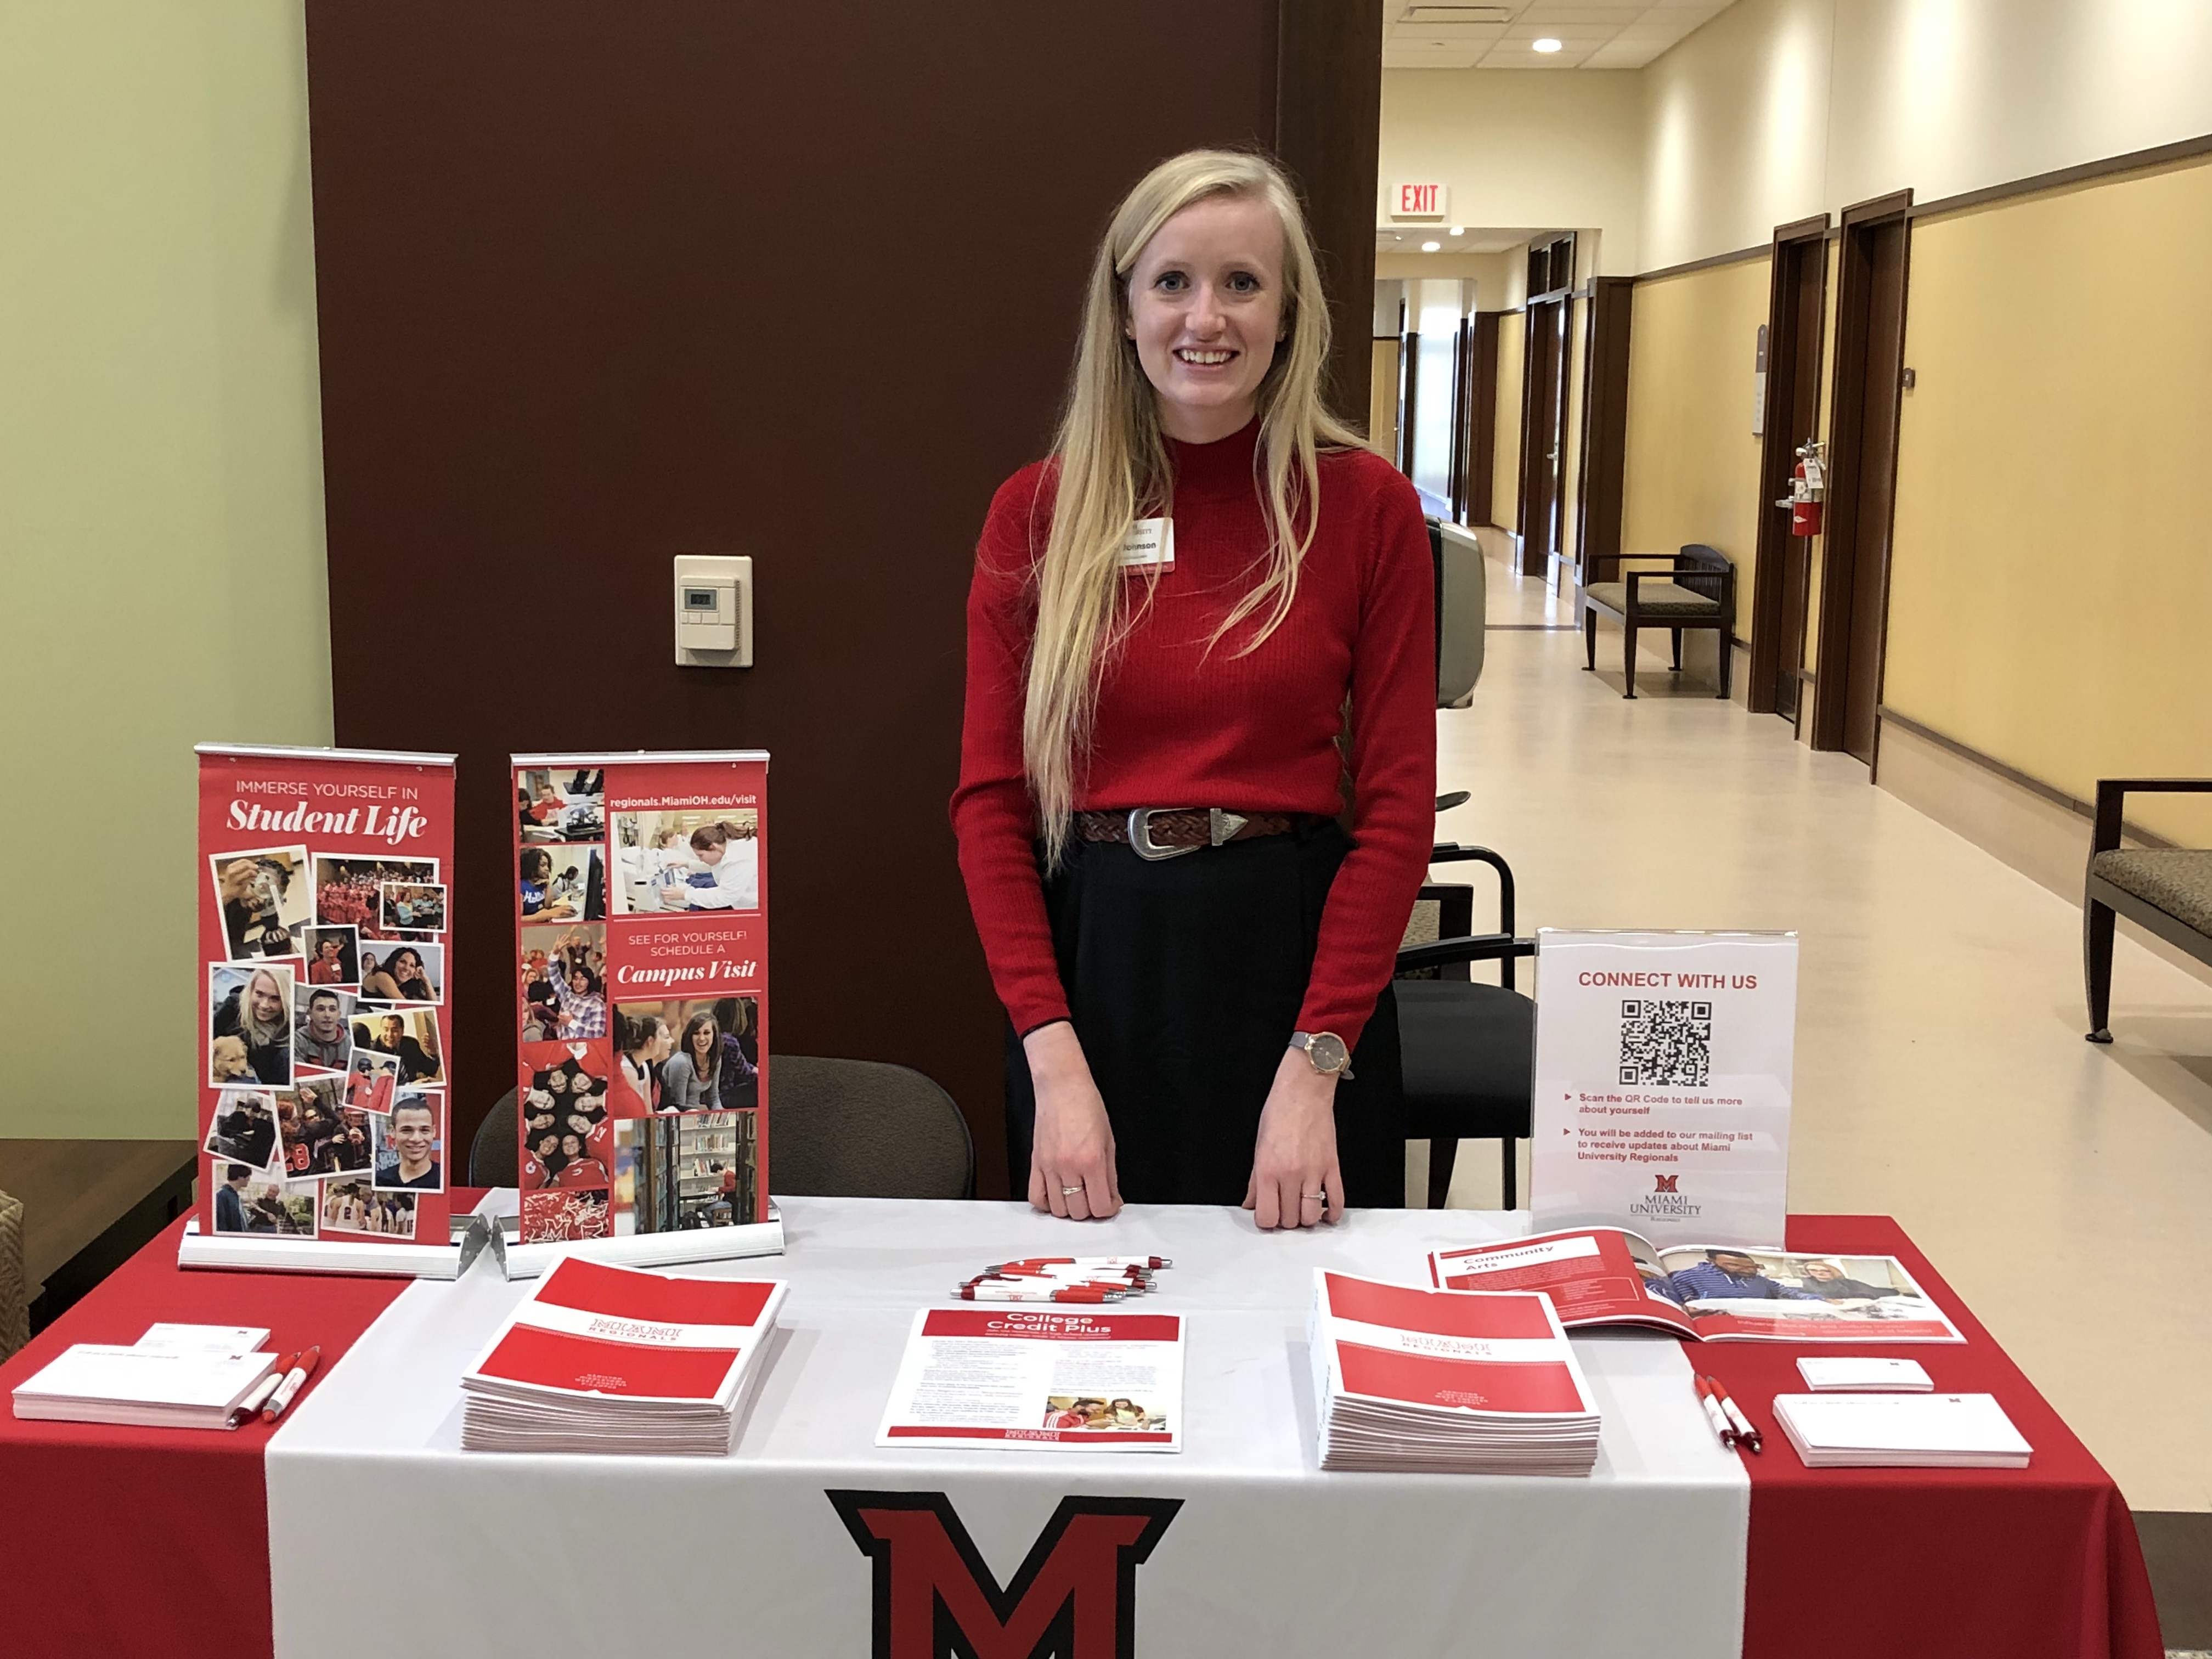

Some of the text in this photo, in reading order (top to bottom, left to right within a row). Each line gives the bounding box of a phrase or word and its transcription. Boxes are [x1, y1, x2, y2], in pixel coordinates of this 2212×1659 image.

[1402, 185, 1438, 212] EXIT
[236, 781, 417, 800] IMMERSE YOURSELF IN
[610, 794, 757, 809] regionals.MiamiOH.edu/visit
[227, 799, 427, 845] Student Life
[629, 931, 747, 945] SEE FOR YOURSELF!
[651, 944, 725, 956] SCHEDULE A
[618, 960, 758, 986] Campus Visit
[1578, 972, 1757, 989] CONNECT WITH US
[1579, 1094, 1604, 1103] Scan
[1606, 1094, 1622, 1103] the
[1625, 1094, 1640, 1104] QR
[1644, 1096, 1668, 1104] Code
[1684, 1096, 1700, 1104] tell
[1579, 1106, 1650, 1115] about yourself
[1578, 1128, 1597, 1137] You
[1599, 1129, 1616, 1137] will
[1619, 1130, 1631, 1138] be
[1634, 1130, 1664, 1138] added
[1699, 1132, 1735, 1142] mailing
[1737, 1132, 1753, 1141] list
[1629, 1142, 1667, 1151] updates
[1671, 1142, 1699, 1151] about
[1701, 1143, 1730, 1152] Miami
[1578, 1152, 1679, 1163] University Regionals
[1654, 1175, 1679, 1193] M
[1645, 1195, 1688, 1205] MIAMI
[1630, 1204, 1702, 1215] UNIVERSITY
[1464, 1246, 1554, 1264] Community
[1466, 1262, 1498, 1271] Arts
[1007, 1313, 1093, 1325] College
[589, 1327, 677, 1341] REGIONALS
[591, 1318, 684, 1337] MIAMI
[987, 1321, 1058, 1331] Credit
[1065, 1324, 1112, 1333] Plus
[823, 1489, 1186, 1659] M
